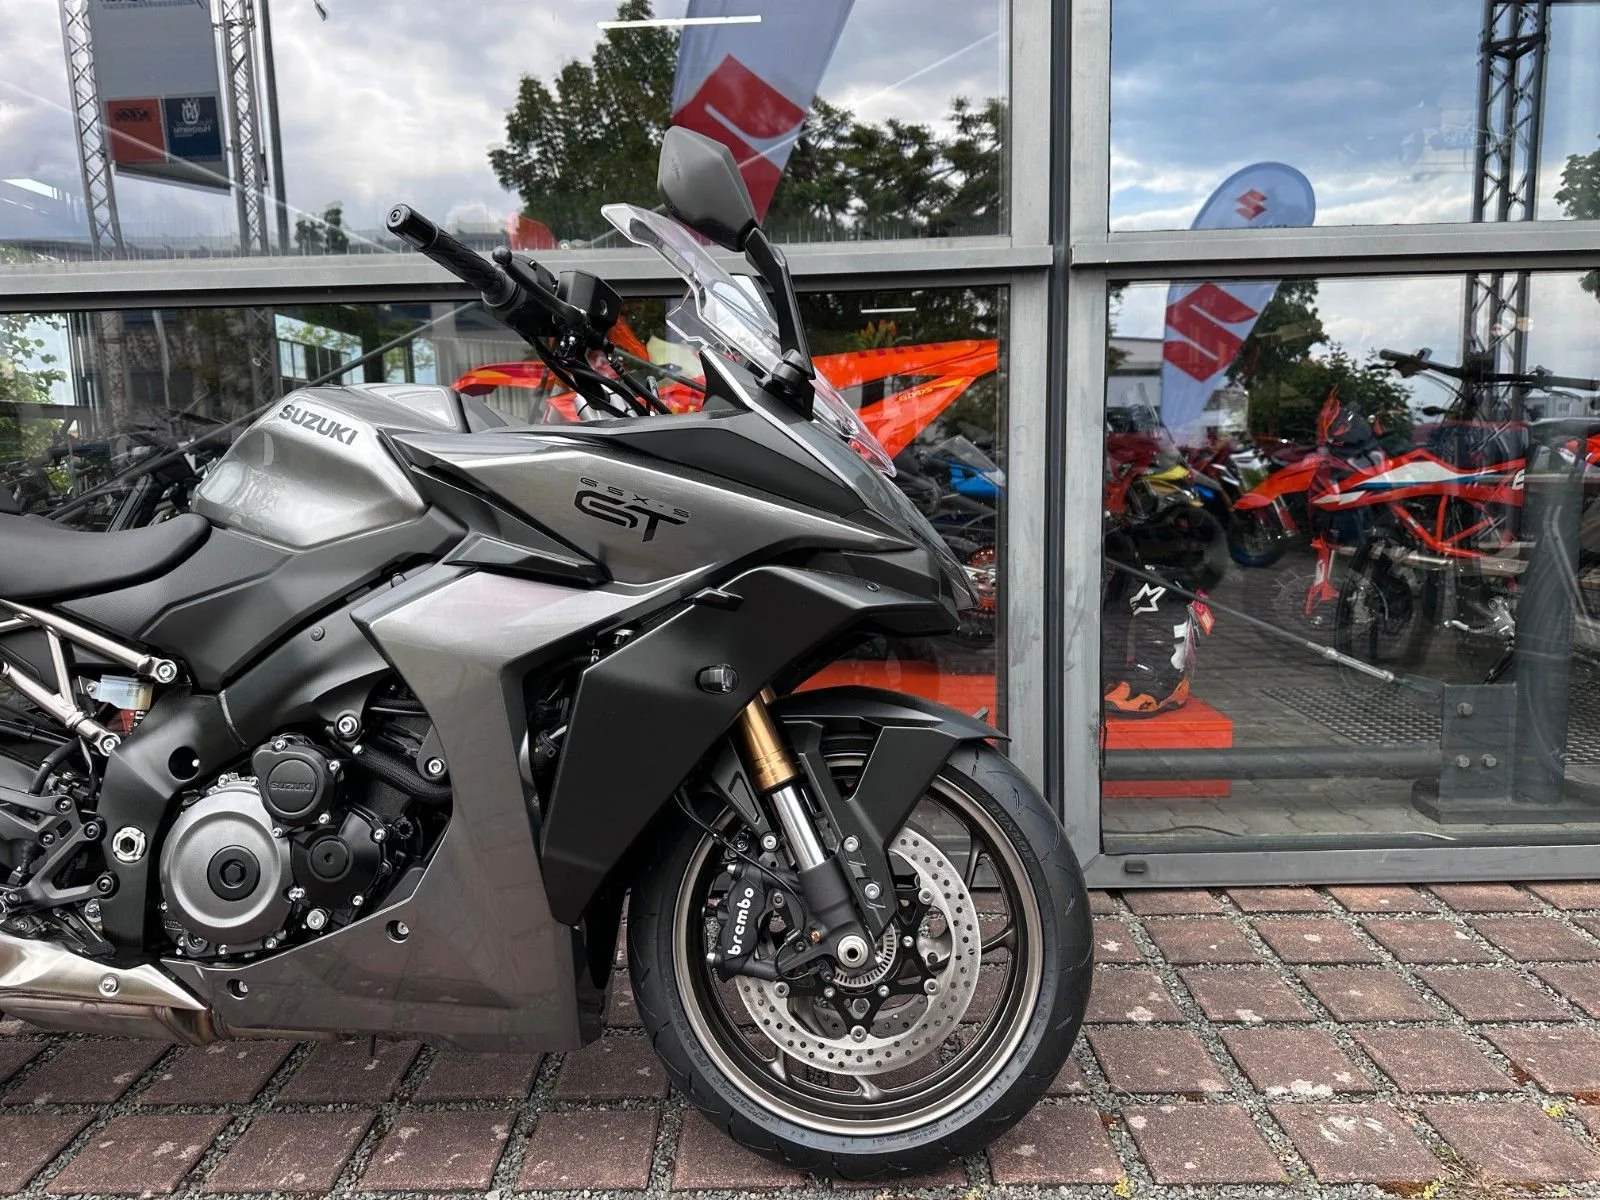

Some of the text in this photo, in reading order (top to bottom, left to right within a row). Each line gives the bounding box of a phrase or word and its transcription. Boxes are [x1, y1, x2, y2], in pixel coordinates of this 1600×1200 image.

[279, 404, 358, 446] SUZUKI
[580, 477, 690, 518] GSX-S
[270, 781, 314, 792] SUZUKI
[727, 887, 754, 955] brembo
